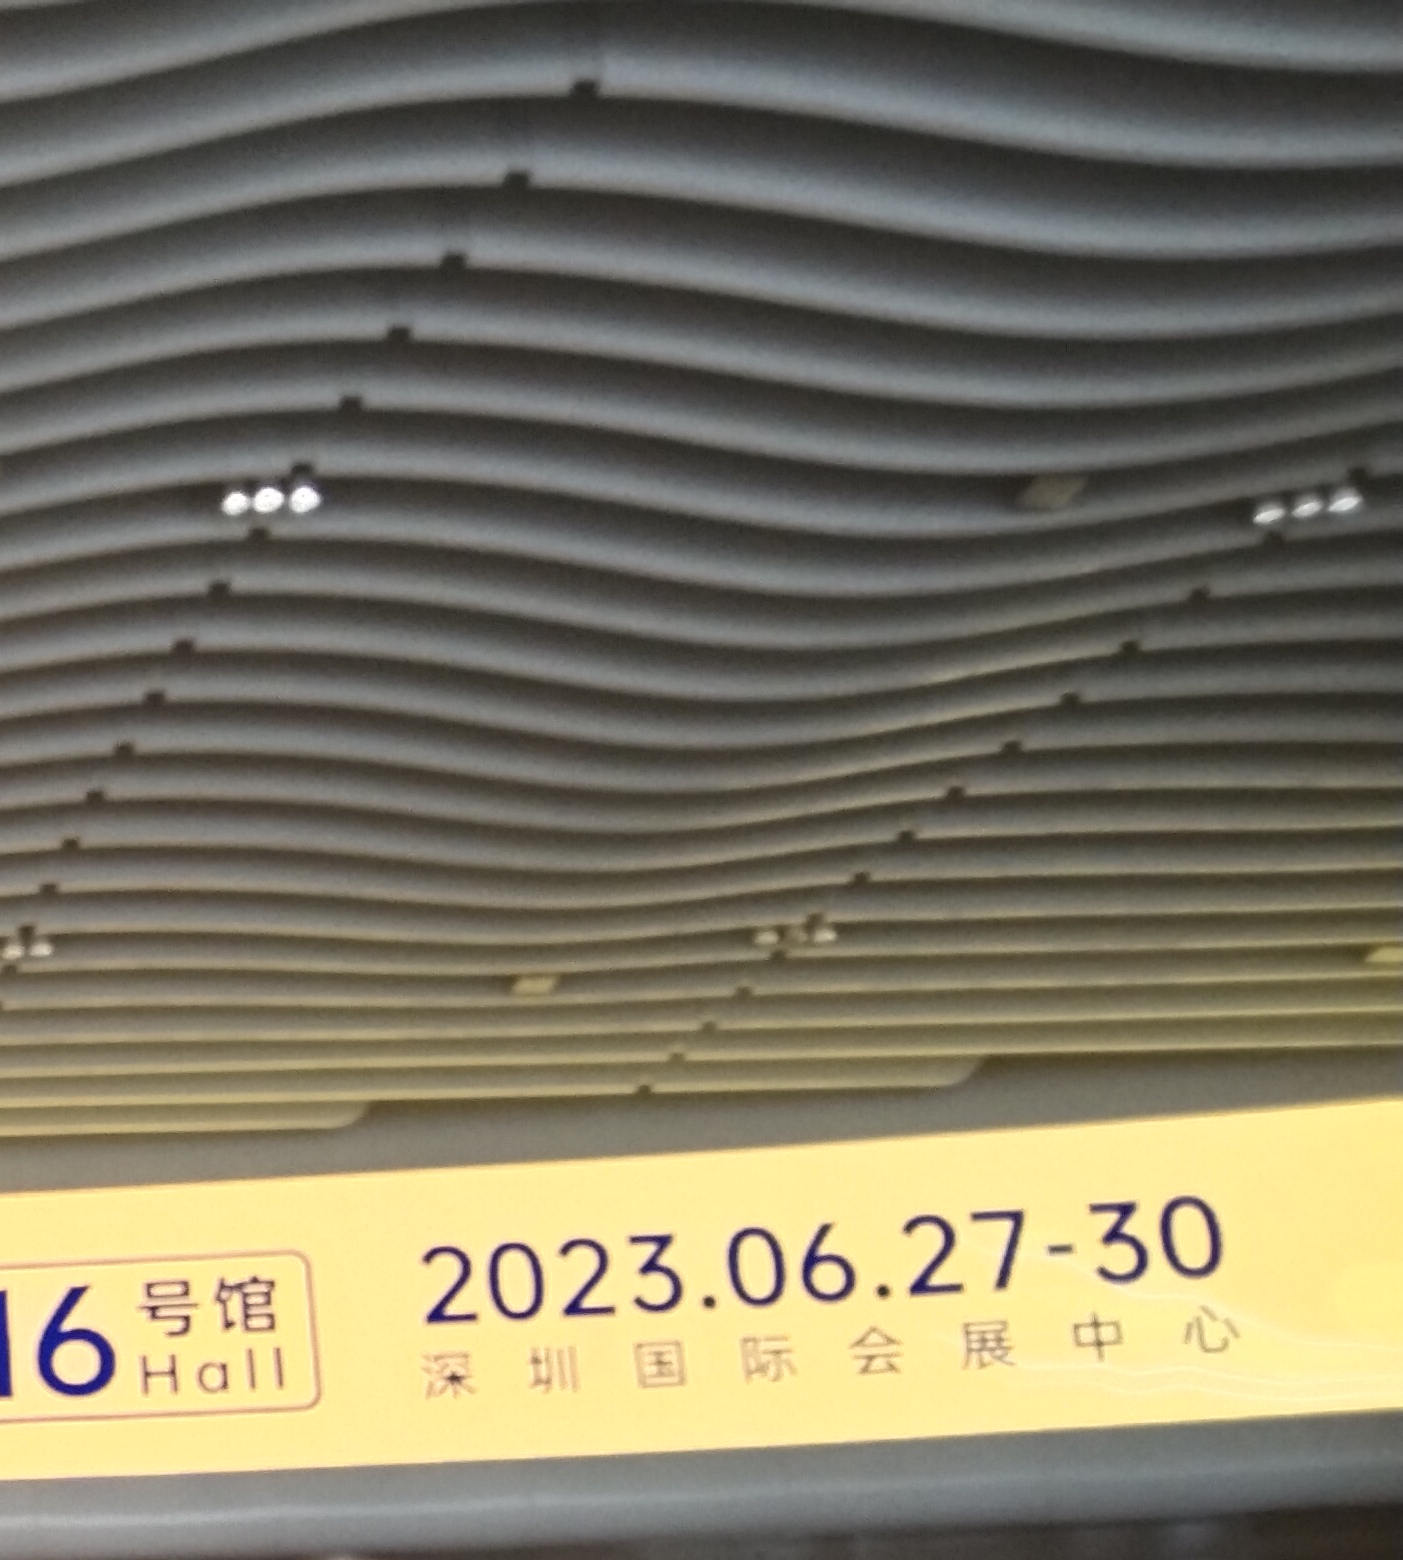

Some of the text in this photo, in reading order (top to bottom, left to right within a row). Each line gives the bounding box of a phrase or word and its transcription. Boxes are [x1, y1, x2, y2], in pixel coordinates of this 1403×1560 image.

[421, 1195, 1225, 1325] 2023.06.27-30
[136, 1274, 277, 1337] 号馆
[138, 1345, 286, 1397] Hall
[419, 1304, 1239, 1400] 深圳国际会展中心
